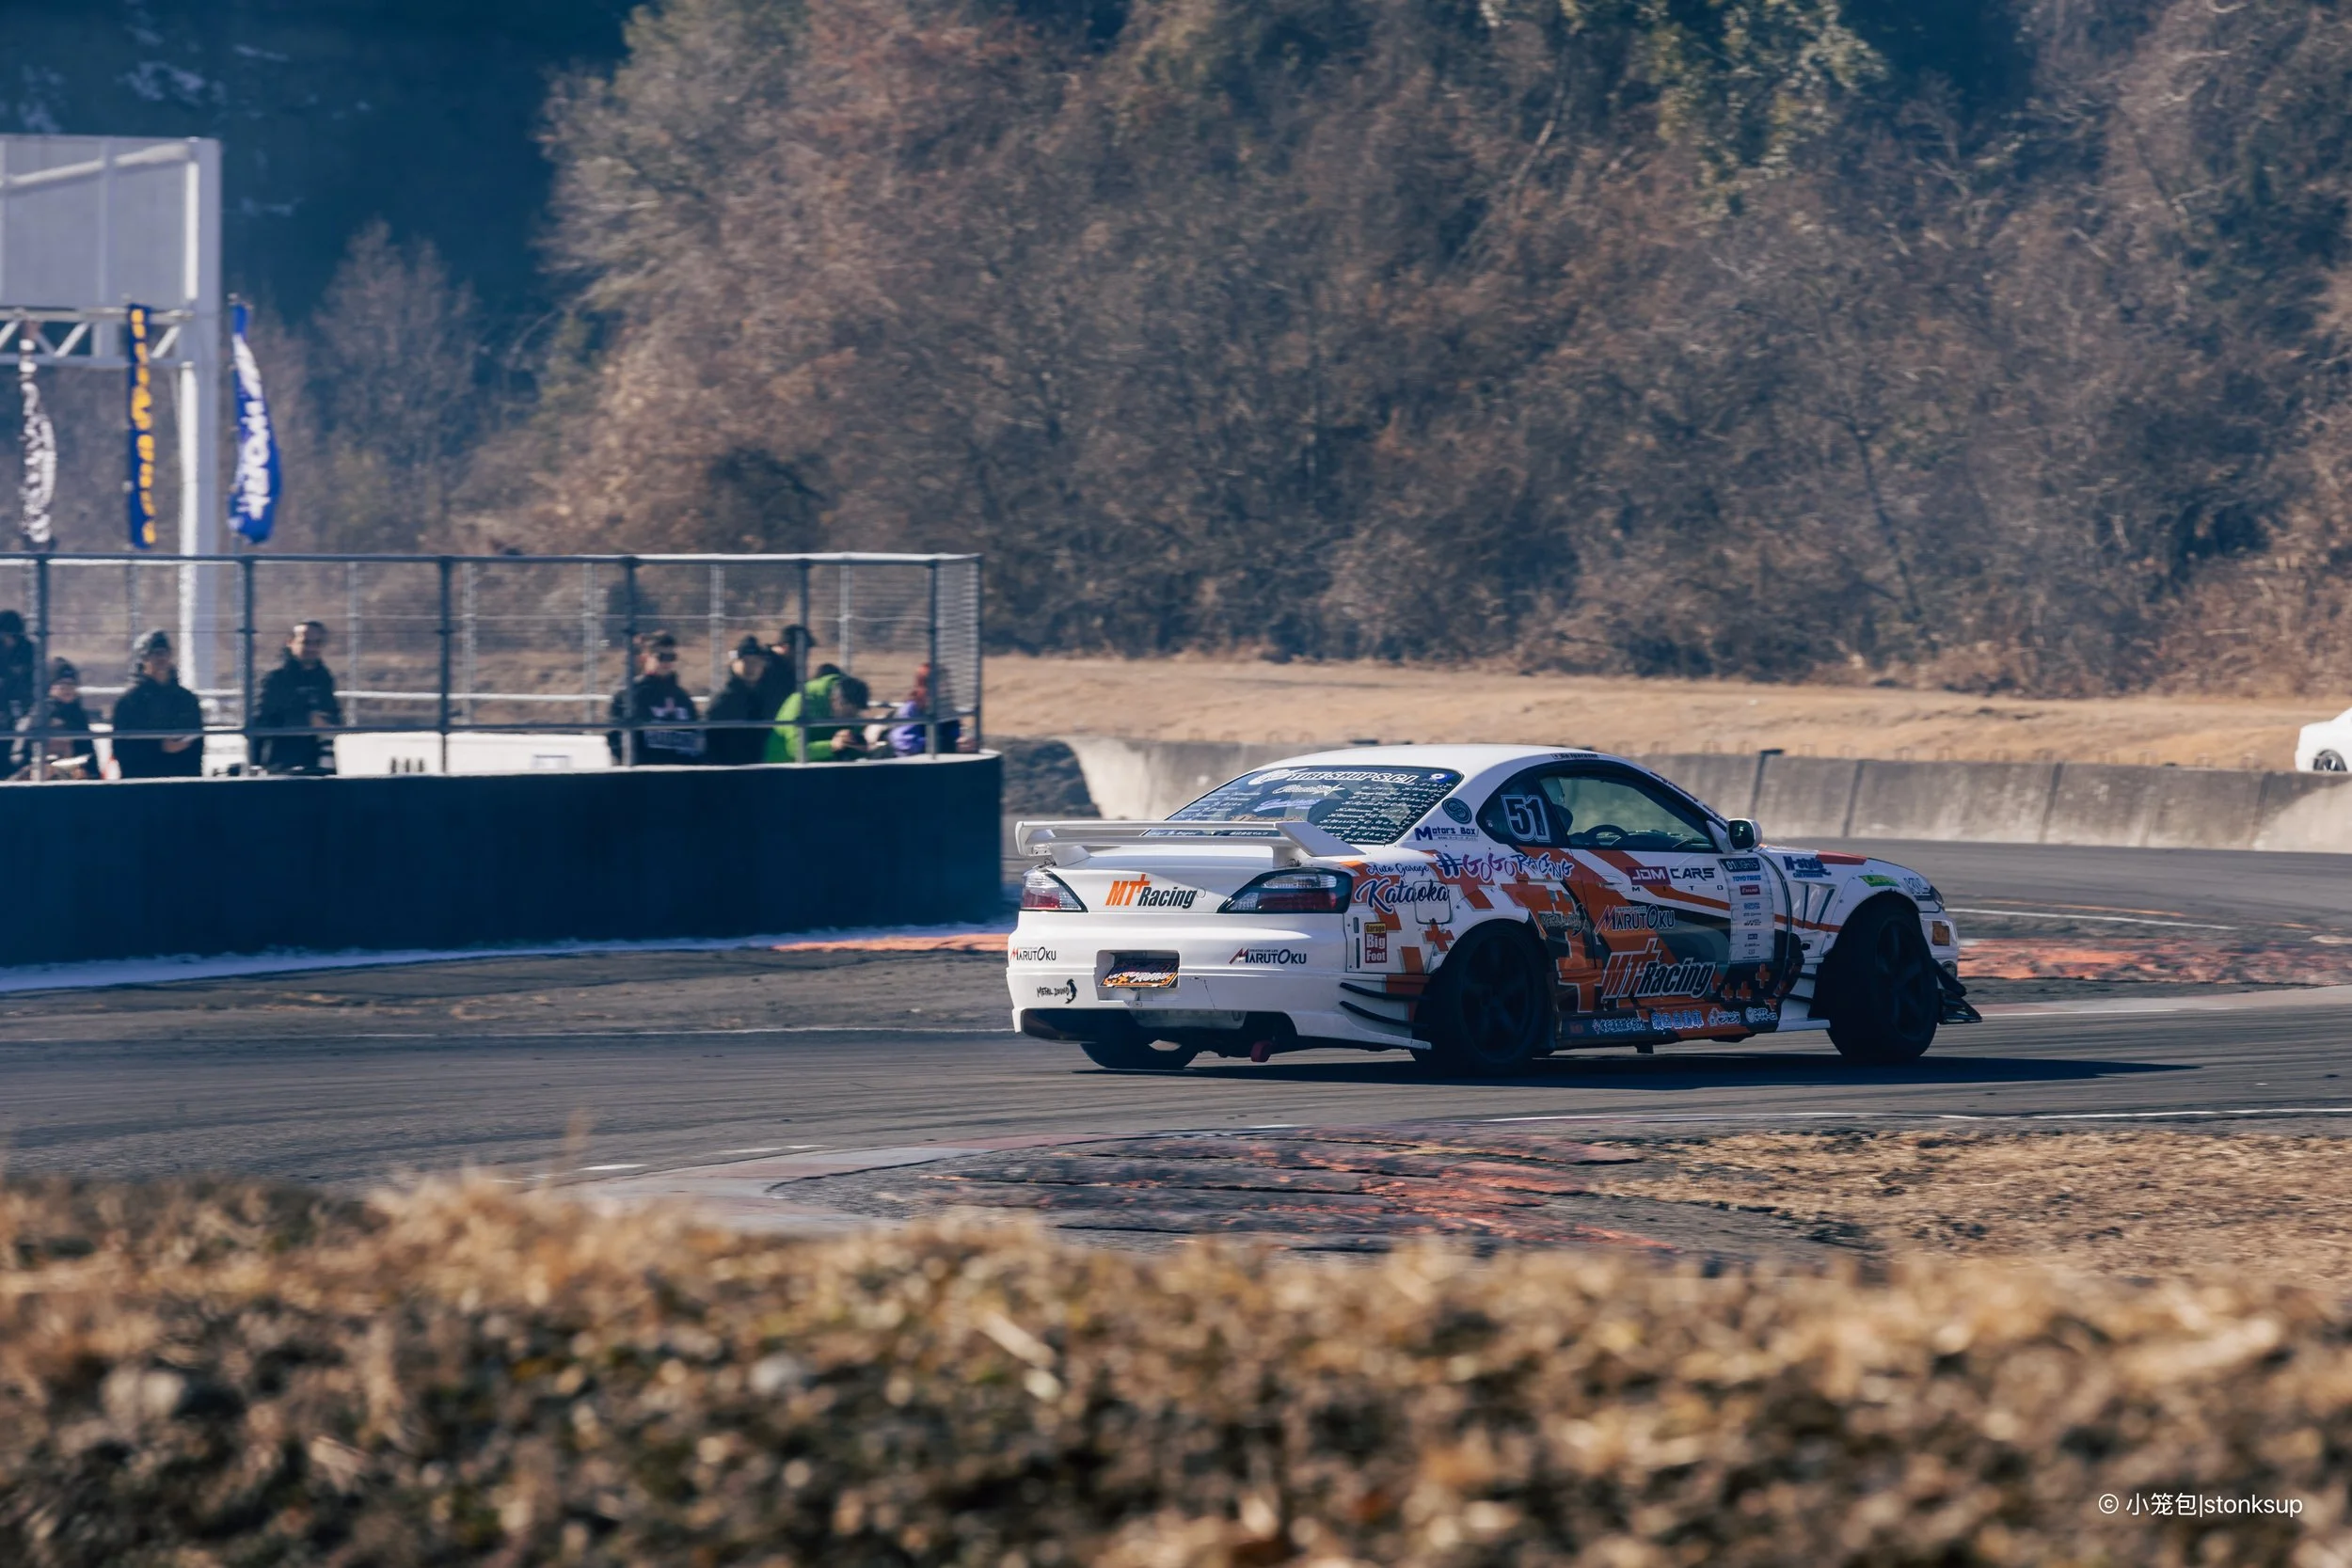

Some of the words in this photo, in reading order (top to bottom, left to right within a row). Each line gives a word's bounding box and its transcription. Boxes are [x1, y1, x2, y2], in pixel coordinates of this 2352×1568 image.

[1502, 795, 1550, 842] 51
[1414, 826, 1455, 841] Motors
[1460, 827, 1476, 835] Box
[1368, 863, 1394, 876] Auto
[1397, 863, 1430, 877] Garage
[1632, 868, 1666, 880] JDM
[1670, 867, 1716, 881] CARS
[1137, 886, 1198, 909] Racing
[1356, 879, 1450, 912] Kataoka
[1366, 934, 1386, 949] Big
[1366, 950, 1386, 961] Foot
[1635, 958, 1716, 999] Racing
